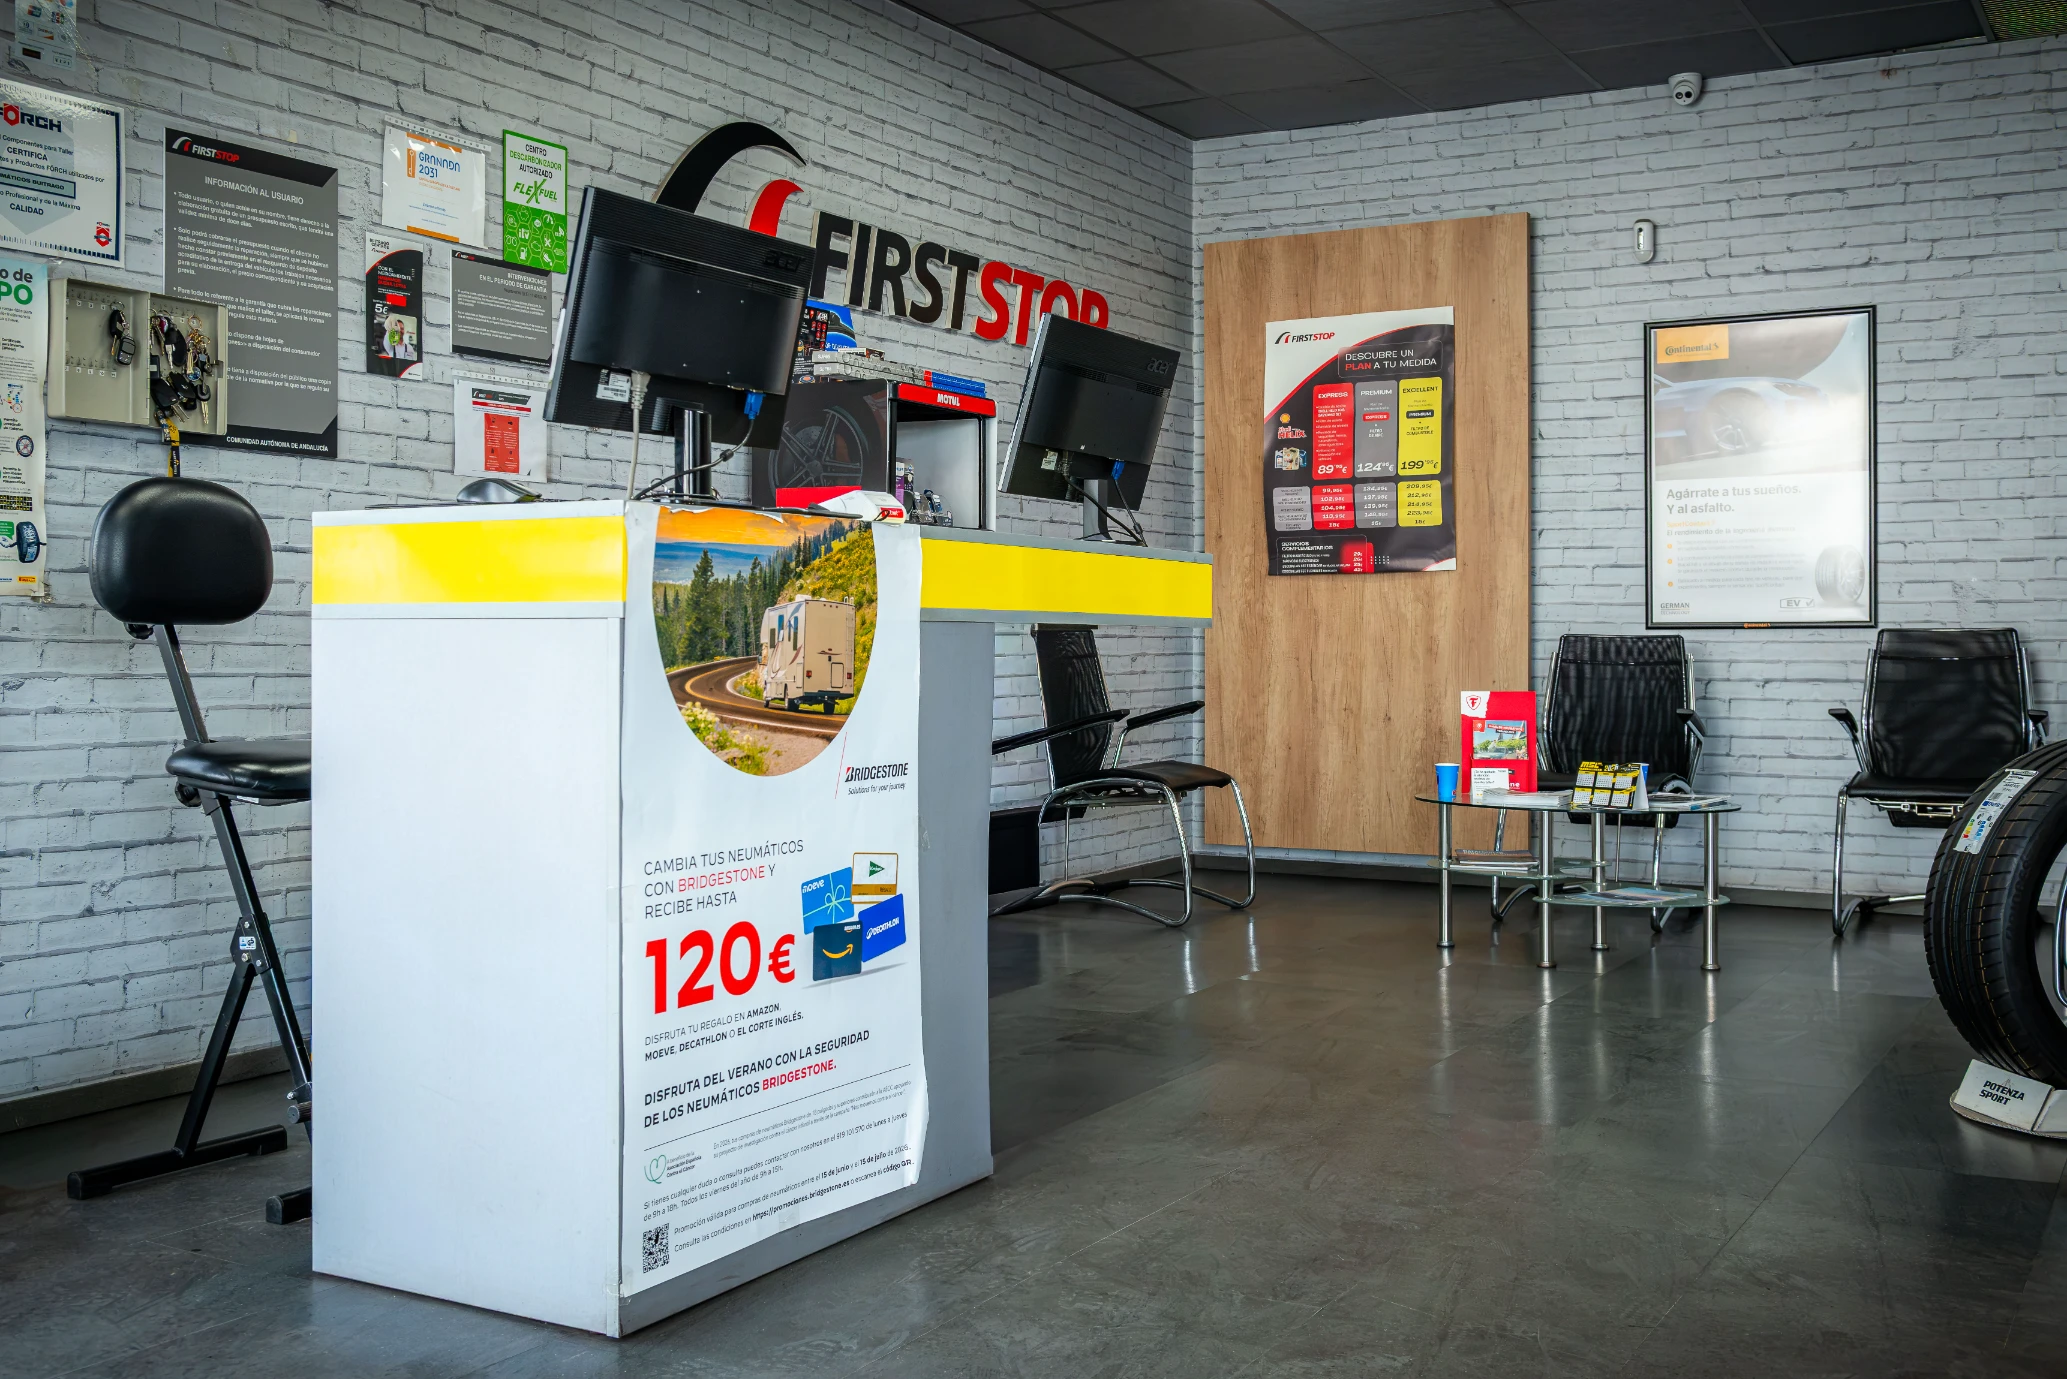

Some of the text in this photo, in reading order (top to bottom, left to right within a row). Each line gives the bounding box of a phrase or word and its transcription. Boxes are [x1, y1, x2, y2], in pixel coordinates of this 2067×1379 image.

[2, 134, 43, 148] Componentes
[7, 146, 48, 161] CERTIFICA
[192, 144, 240, 162] FIRSTSTOP
[526, 144, 547, 156] CENTRO
[510, 150, 562, 171] DESCARBONIZADOR
[15, 158, 45, 169] Productos
[68, 170, 94, 180] utilizados
[419, 164, 438, 178] 2031
[519, 164, 553, 178] AUTORIZADO
[205, 176, 304, 204] INFORMACIÓN AL USUARIO
[513, 179, 558, 204] FLEXFUEL
[10, 203, 44, 215] CALIDAD
[12, 268, 33, 283] de
[516, 281, 523, 289] DE
[524, 283, 547, 293] GARANTÍA
[374, 303, 388, 314] 5€
[1292, 332, 1335, 343] FIRSTSTOP
[252, 342, 281, 351] disposición
[1346, 349, 1414, 360] DESCUBRE UN
[1665, 342, 1712, 356] Continental
[1147, 358, 1173, 375] acer
[1345, 362, 1372, 371] PLAN
[1383, 360, 1396, 368] TU
[1400, 358, 1437, 367] MEDIDA
[1402, 386, 1439, 394] EXCELLENT
[937, 393, 960, 407] MOTUL
[1278, 430, 1307, 439] HELIX
[226, 436, 260, 445] COMUNIDAD
[260, 439, 290, 448] AUTÓNOMA
[299, 443, 328, 452] ANDALUCÍA
[1667, 488, 1719, 500] Agárrate
[1732, 487, 1751, 496] tus
[1754, 484, 1801, 496] sueños.
[1667, 502, 1735, 514] Y al asfalto.
[845, 762, 909, 782] BRIDGESTONE
[848, 787, 870, 795] Solutions
[878, 785, 889, 793] your
[644, 838, 804, 875] CAMBIA TUS NEUMÁTICOS
[644, 863, 776, 897] CON BRIDGESTONE Y
[802, 880, 824, 893] moeve
[644, 890, 737, 918] RECIBE HASTA
[873, 917, 899, 935] DECATHLON
[645, 1003, 782, 1045] DISFRUTA TU REGALO EN AMAZON,
[645, 1011, 804, 1061] MOEVE, DECATHLON O EL CORTE INGLÉS.
[644, 1028, 870, 1105] DISFRUTA DEL VERANO CON LA SEGURIDAD
[644, 1059, 837, 1128] DE LOS NEUMÁTICOS BRIDGESTONE.
[1979, 1089, 2011, 1105] SPORT
[1983, 1080, 2025, 1101] POTENZA
[643, 1111, 908, 1210] Si tienes cualquier duda consulta puedes contactar con nosotros 919 101 570 de lunes jueves
[644, 1164, 783, 1221] de 9h 18h. Todos los viernes del año de 9h 15h.
[674, 1217, 706, 1234] Promoción
[706, 1211, 724, 1223] válida
[724, 1206, 737, 1218] para
[737, 1197, 761, 1211] compras
[762, 1194, 769, 1202] de
[770, 1182, 800, 1199] neumáticos
[801, 1177, 815, 1187] entre
[821, 1170, 827, 1180] 15
[828, 1169, 835, 1177] de
[835, 1164, 850, 1176] junio
[860, 1157, 867, 1166] 15
[867, 1155, 874, 1164] de
[674, 1236, 701, 1252] Consulta
[701, 1233, 709, 1241] las
[710, 1221, 744, 1238] condiciones
[744, 1218, 752, 1226] en
[855, 1170, 877, 1183] escanea
[883, 1162, 901, 1173] código
